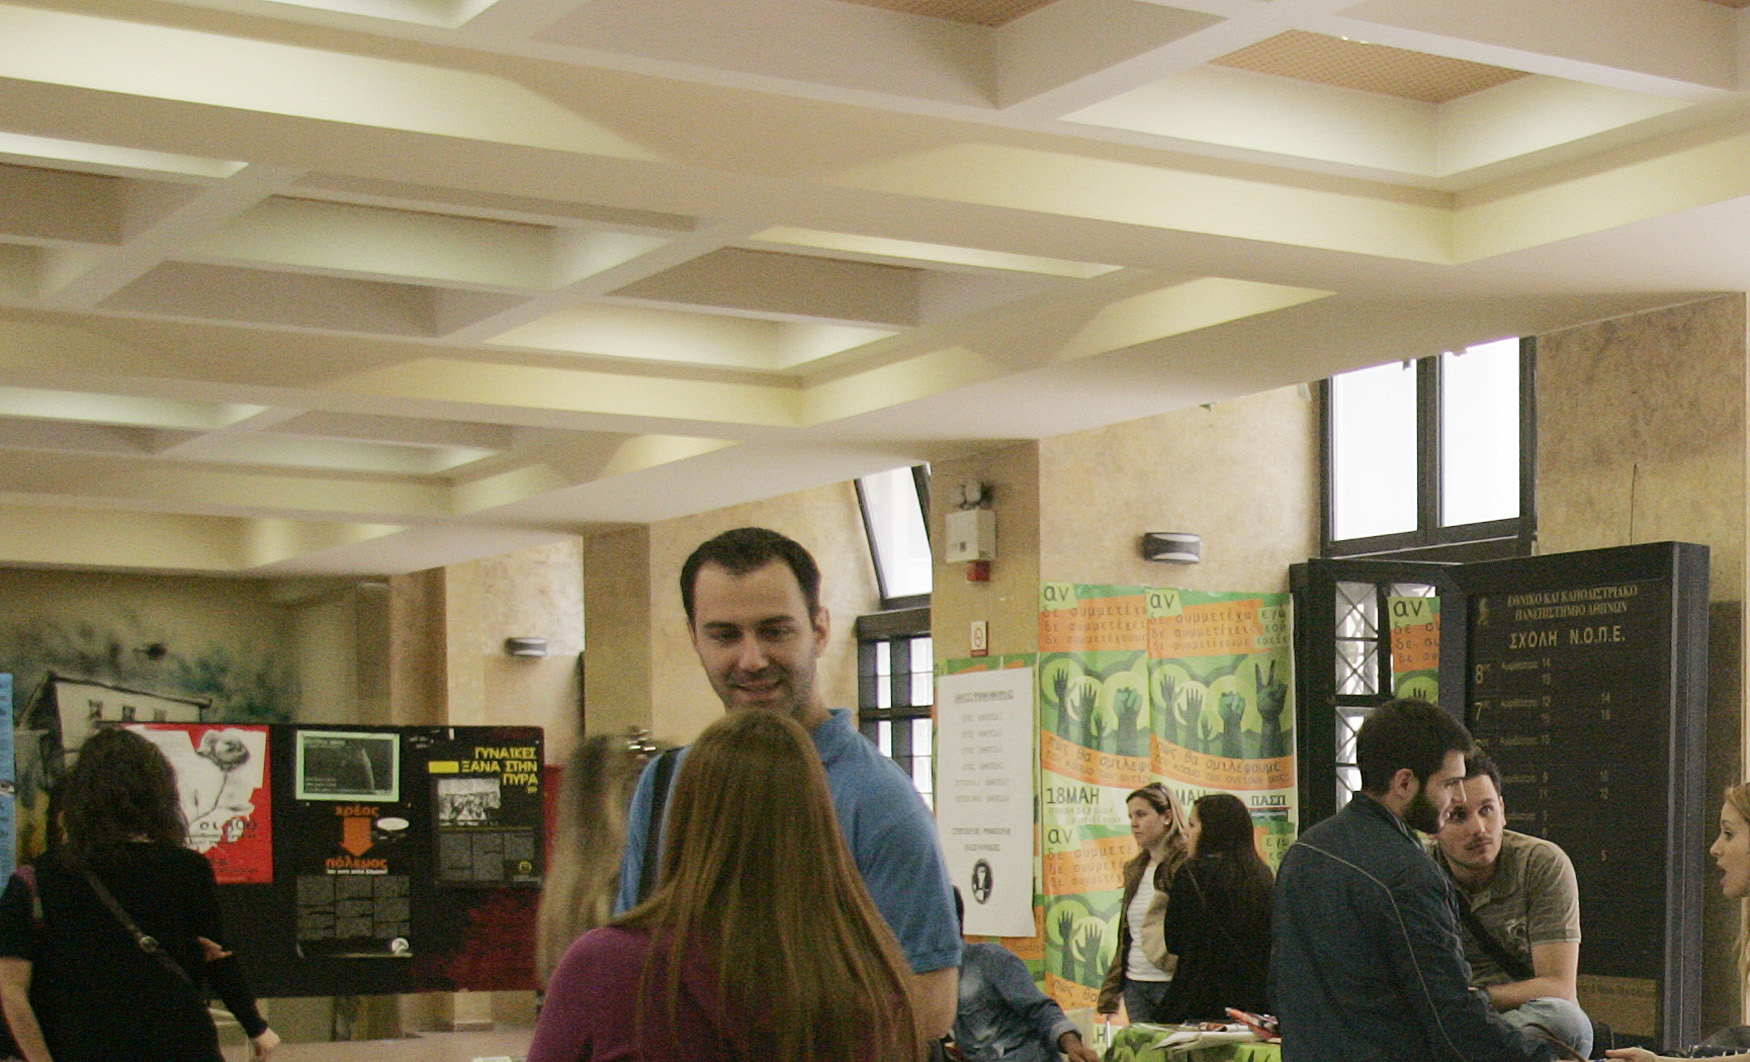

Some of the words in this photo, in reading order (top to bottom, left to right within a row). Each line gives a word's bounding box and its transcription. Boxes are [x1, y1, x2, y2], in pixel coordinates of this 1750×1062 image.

[1043, 586, 1070, 603] αν
[1150, 593, 1175, 610] αν
[1394, 600, 1422, 619] αν
[1508, 630, 1559, 650] ΣΧΟΛΗ
[1569, 625, 1626, 645] Ν.Ο.Π.Ε.
[474, 746, 537, 760] ΓΥΝΑΙΚΕΣ
[461, 761, 501, 773] ΞΑΝΑ
[505, 761, 538, 773] ΣΤΗΝ
[503, 773, 539, 786] ΠΥΡΑ
[1046, 787, 1100, 806] 18ΜΑΗ
[1251, 794, 1287, 807] ΠΑΣΠ
[1047, 828, 1073, 845] αν
